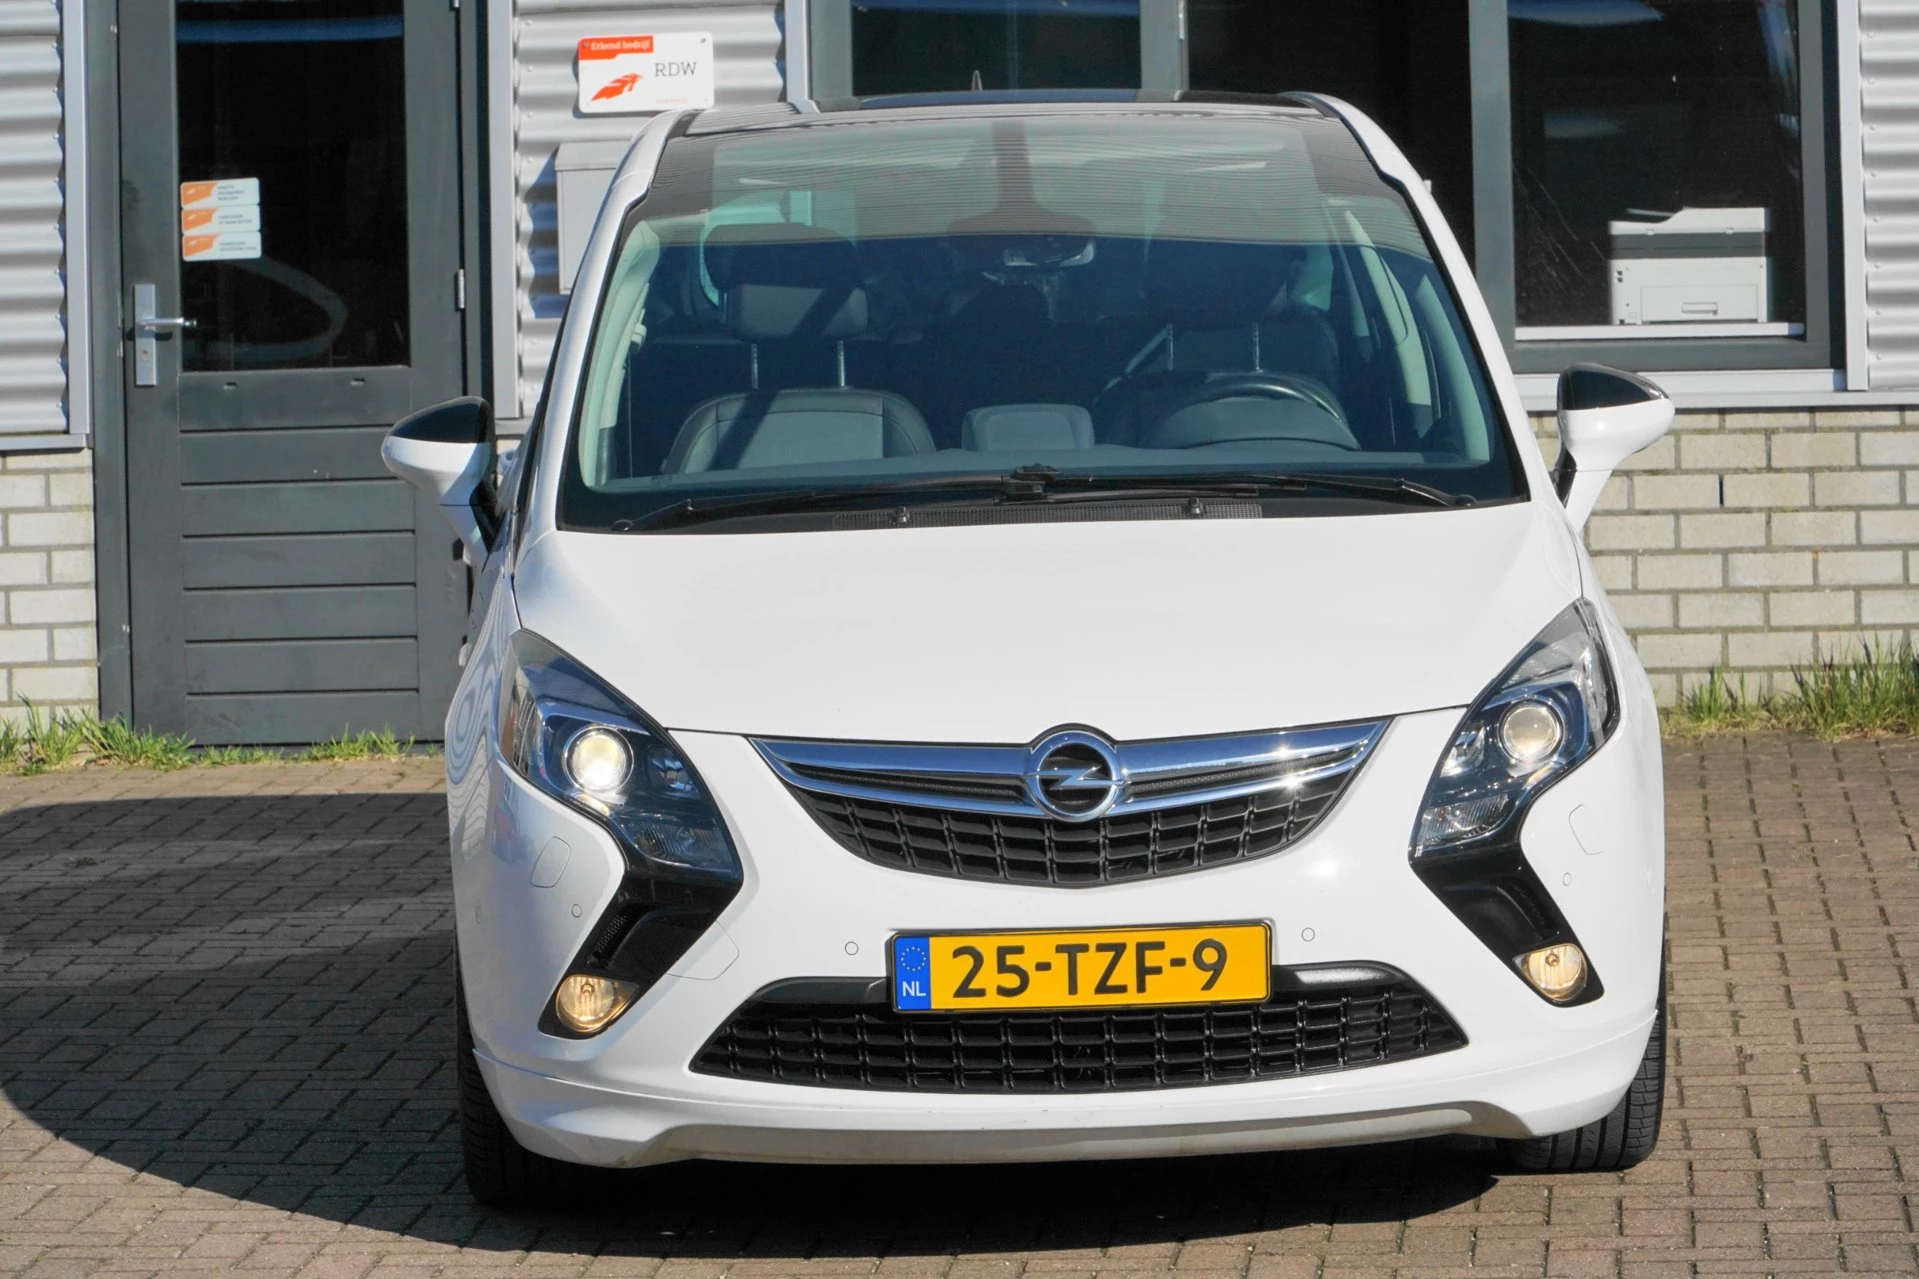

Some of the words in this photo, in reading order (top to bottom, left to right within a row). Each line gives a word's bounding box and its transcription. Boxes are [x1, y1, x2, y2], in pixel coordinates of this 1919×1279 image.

[654, 61, 697, 77] RDW
[952, 938, 1227, 998] 25-TZF-9
[902, 980, 926, 997] NL
